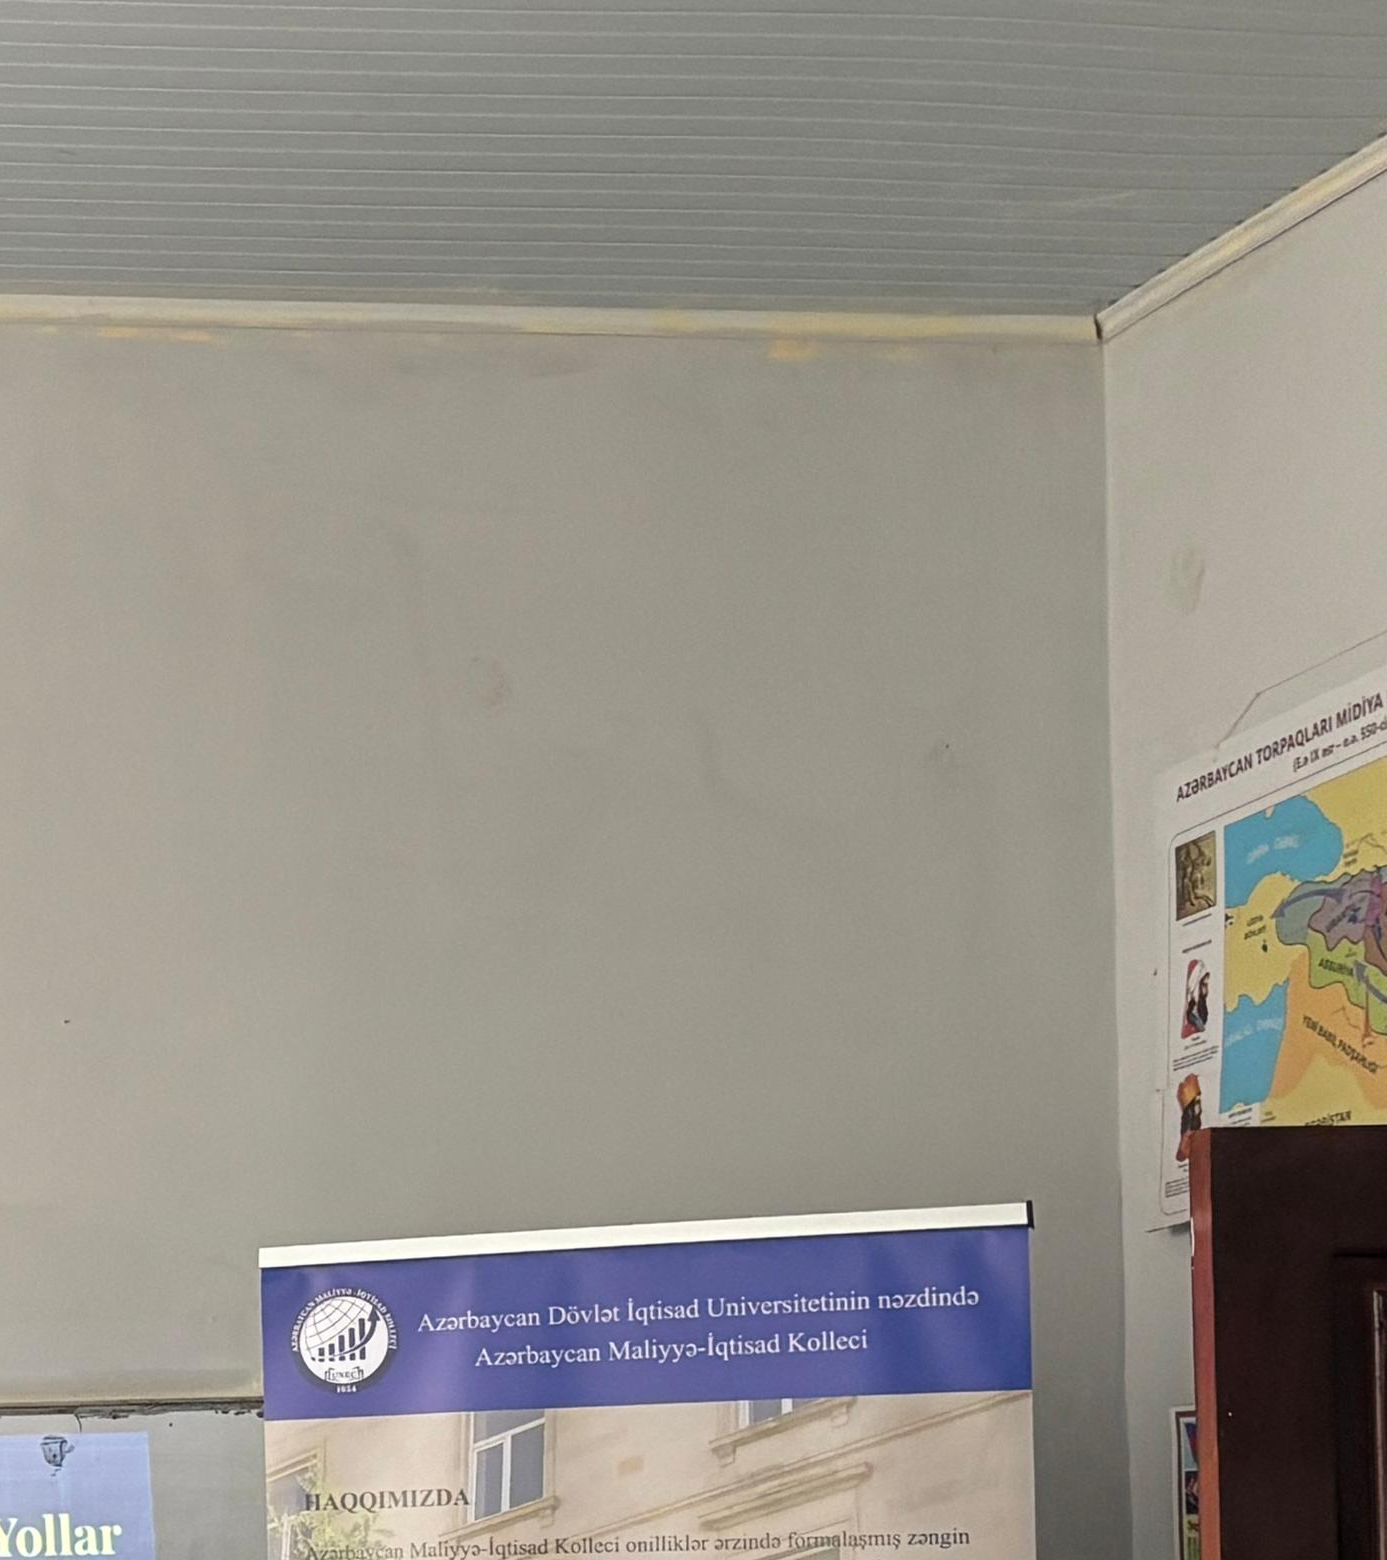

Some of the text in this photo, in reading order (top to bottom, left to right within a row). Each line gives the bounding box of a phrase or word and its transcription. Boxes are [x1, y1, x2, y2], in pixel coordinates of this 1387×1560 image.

[1176, 693, 1383, 803] AZƏRBAYCAN TORPAQLARI MİDİYA
[418, 1286, 979, 1332] Azərbaycan Dövlət İqtisad Universitetinin nəzdində
[475, 1329, 868, 1368] Azərbaycan Maliyyə-İqtisad Kolleci
[305, 1489, 470, 1513] HAQQIMIZDA
[410, 1536, 548, 1560] Maliyyə-İqtisad
[555, 1537, 619, 1554] Kolleci
[626, 1534, 709, 1553] onilliklər
[715, 1532, 781, 1551] ərzində
[789, 1530, 901, 1550] formalaşmış
[908, 1528, 971, 1549] zəngin
